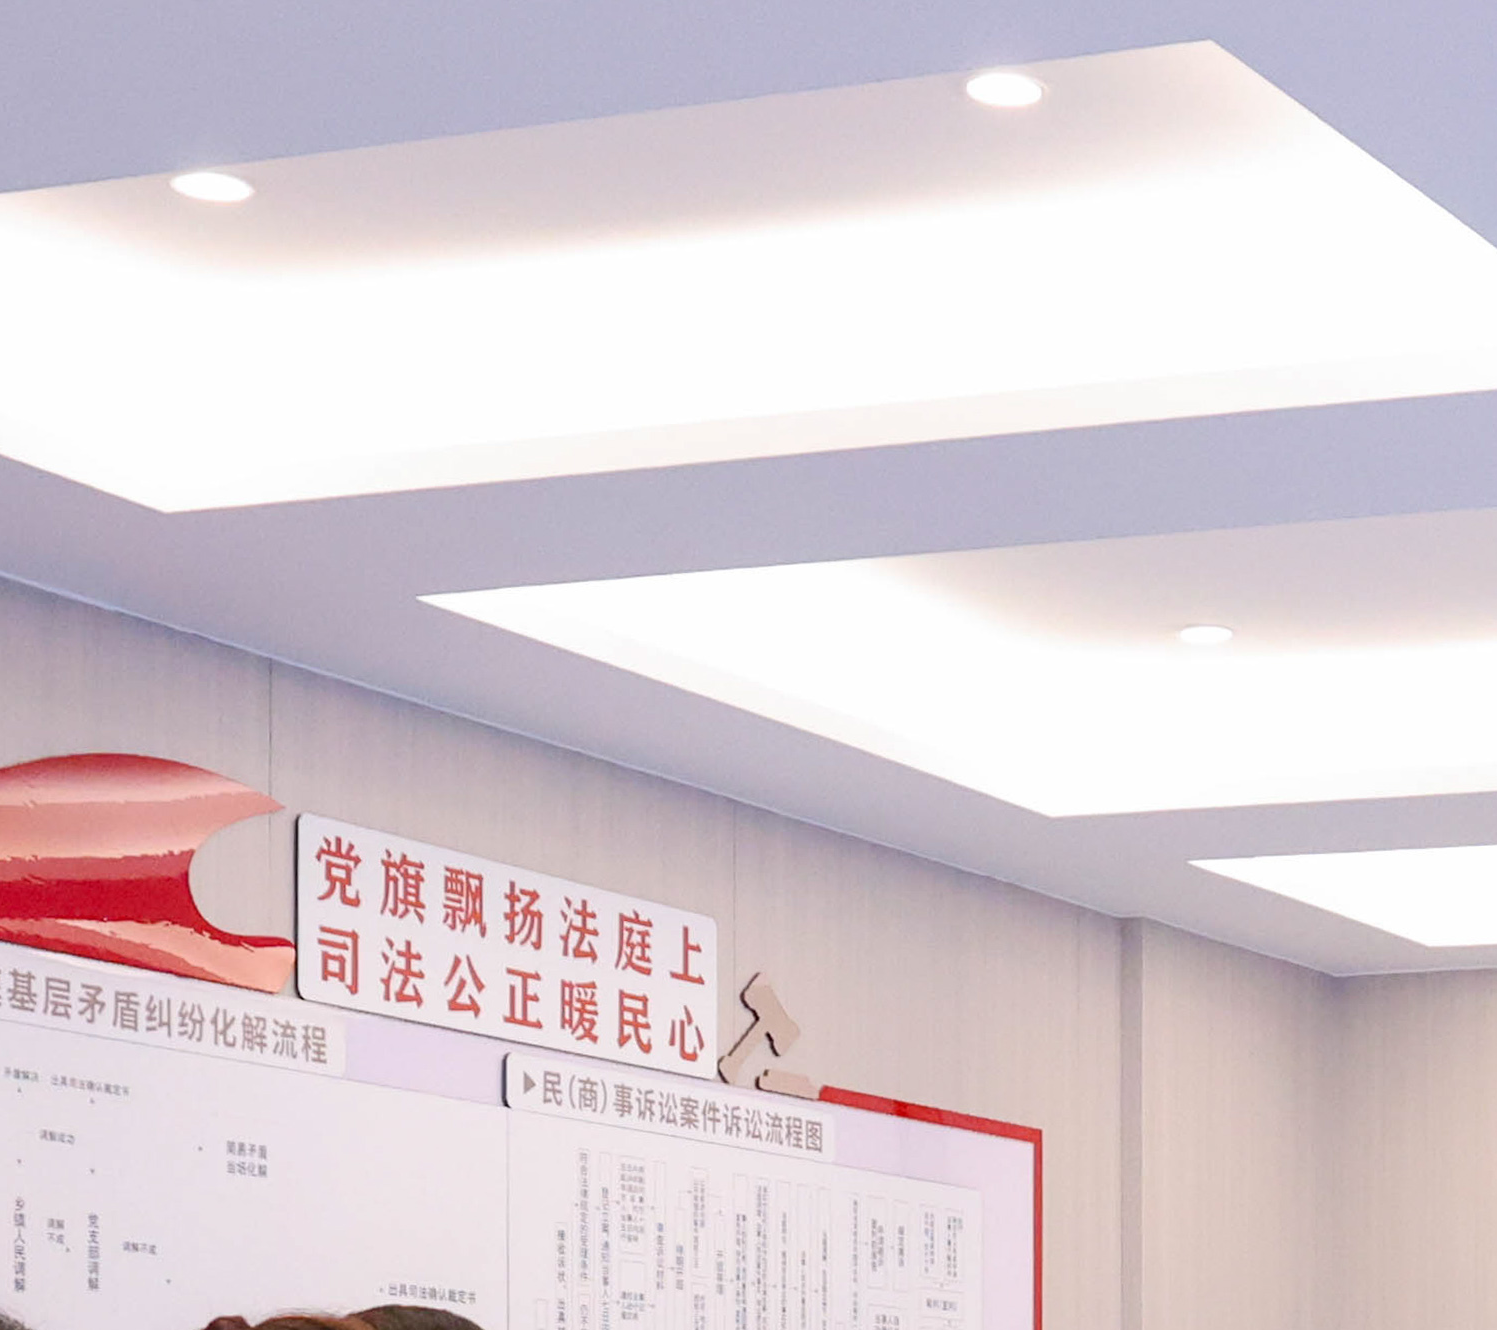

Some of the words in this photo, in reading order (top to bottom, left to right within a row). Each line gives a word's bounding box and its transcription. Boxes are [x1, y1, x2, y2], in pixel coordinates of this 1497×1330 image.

[315, 836, 705, 986] 党旗飘扬法庭上
[316, 925, 705, 1063] 司法公正暖民心
[14, 1196, 26, 1292] 乡镇人民调解
[388, 1283, 477, 1305] 出具司法确认裁定书
